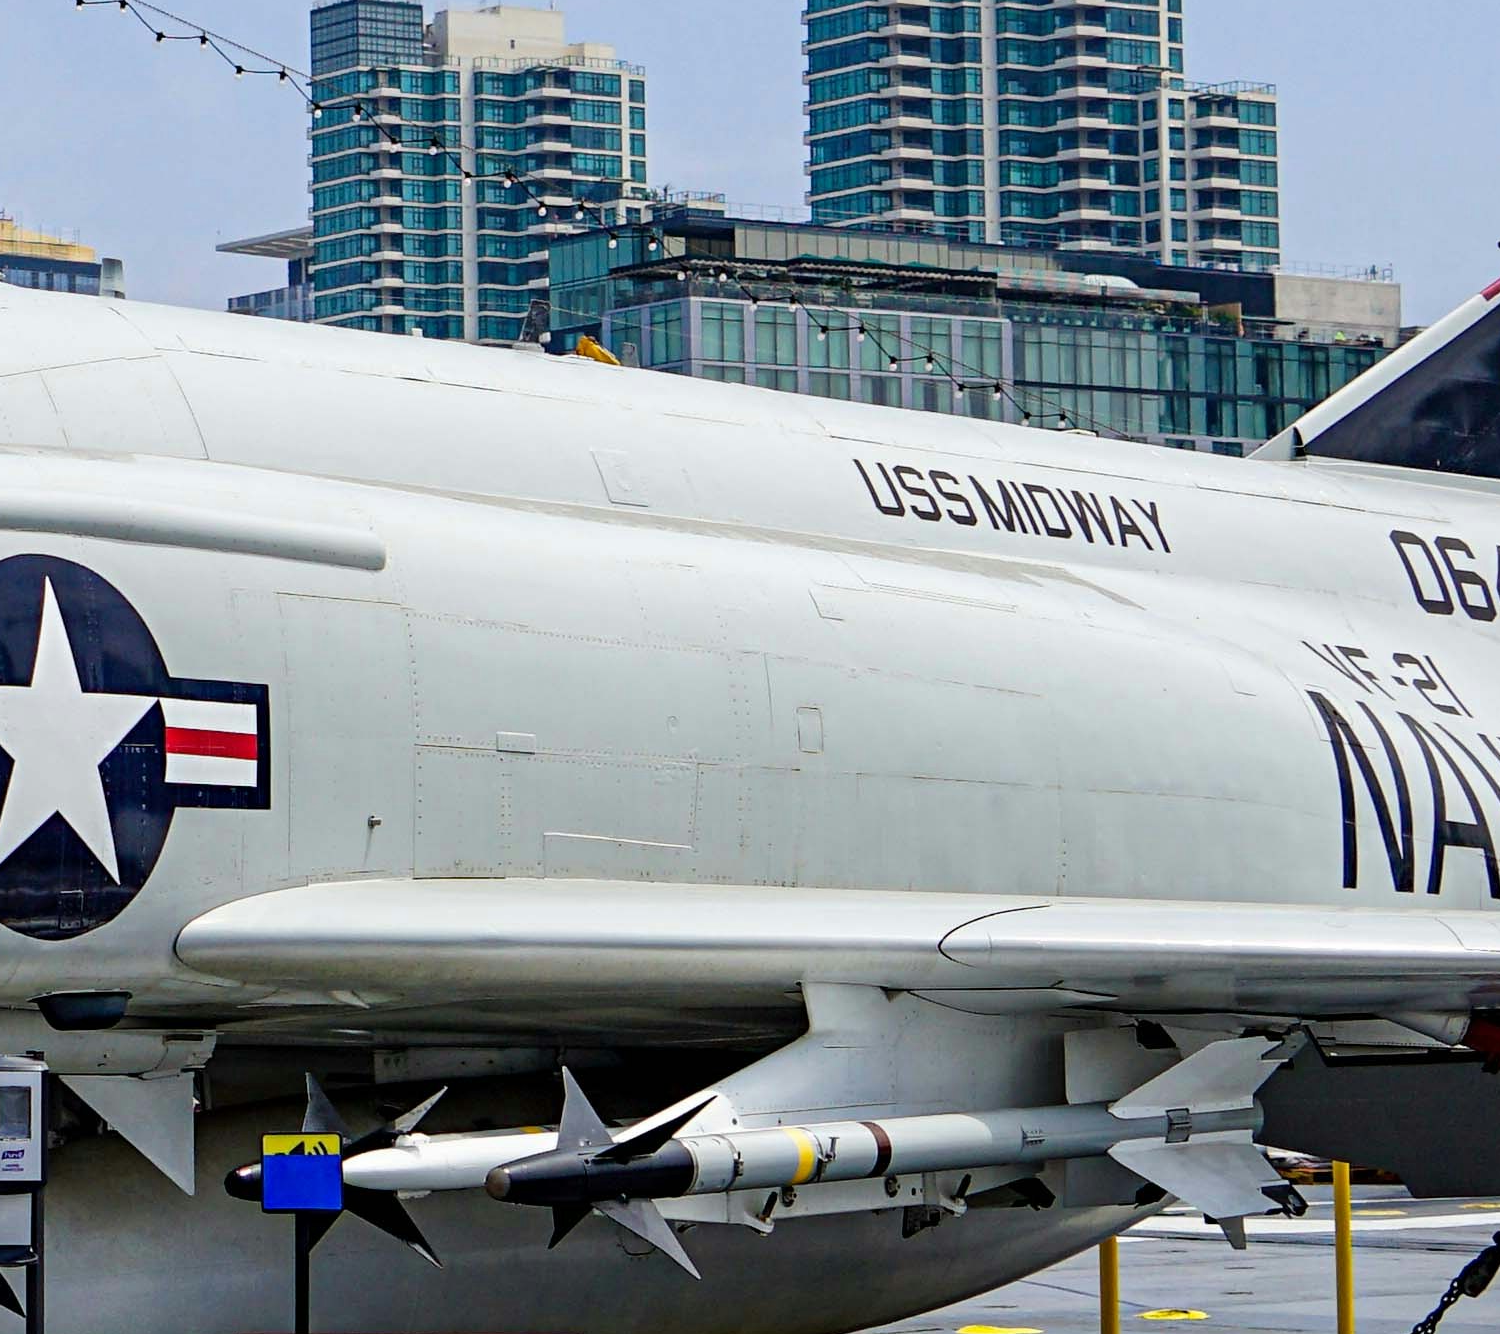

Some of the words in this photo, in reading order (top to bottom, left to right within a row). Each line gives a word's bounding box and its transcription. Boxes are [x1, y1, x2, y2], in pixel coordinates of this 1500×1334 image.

[852, 458, 979, 528] USS
[966, 473, 1172, 554] MIDWAY
[1301, 639, 1474, 718] VF-21
